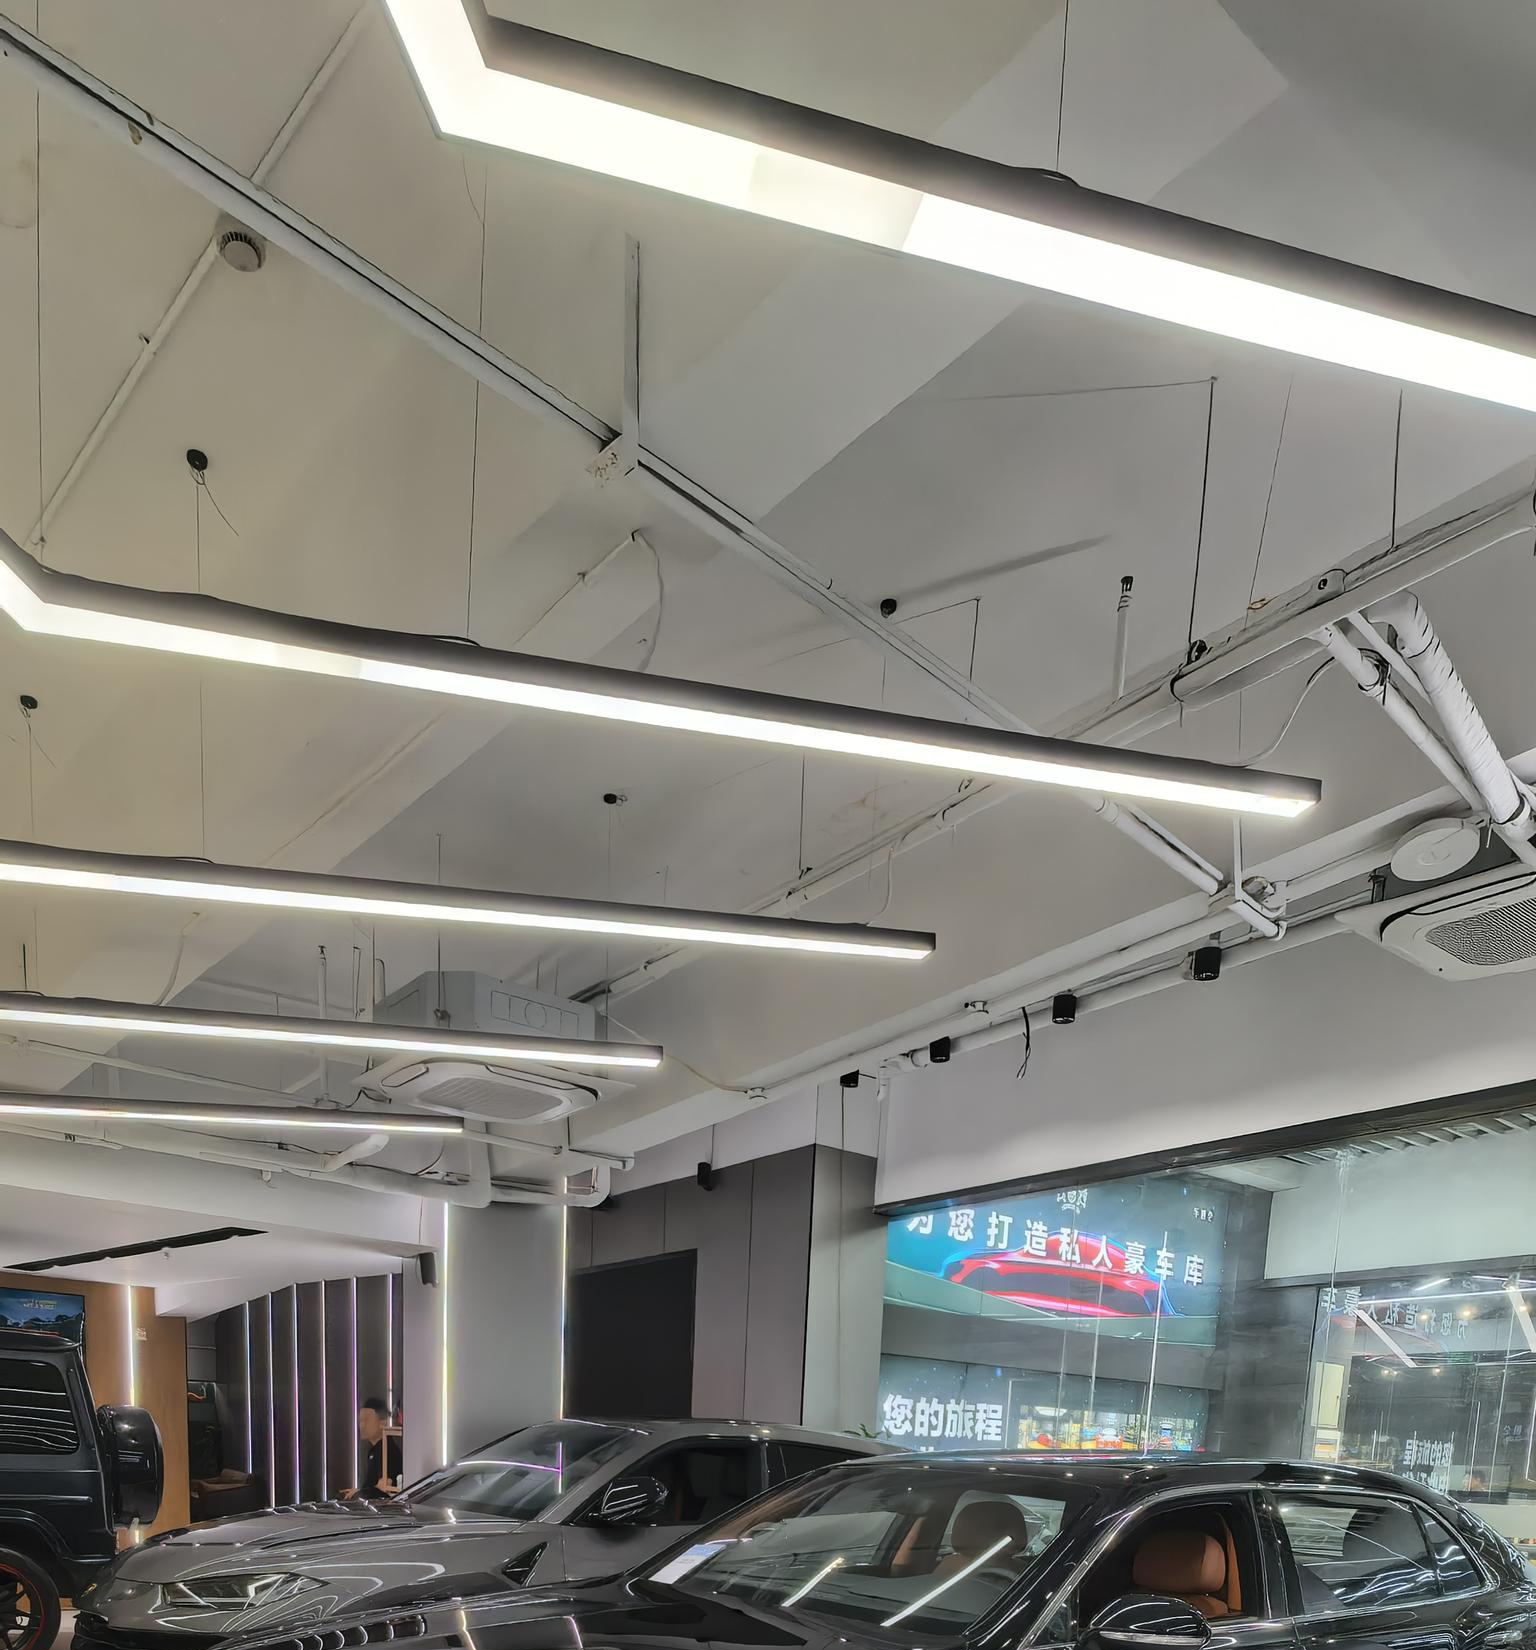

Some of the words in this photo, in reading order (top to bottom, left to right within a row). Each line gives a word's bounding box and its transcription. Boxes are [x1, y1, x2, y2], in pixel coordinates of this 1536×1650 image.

[906, 1208, 1205, 1286] 为您打造私人豪车库
[883, 1393, 1003, 1441] 您的旅程
